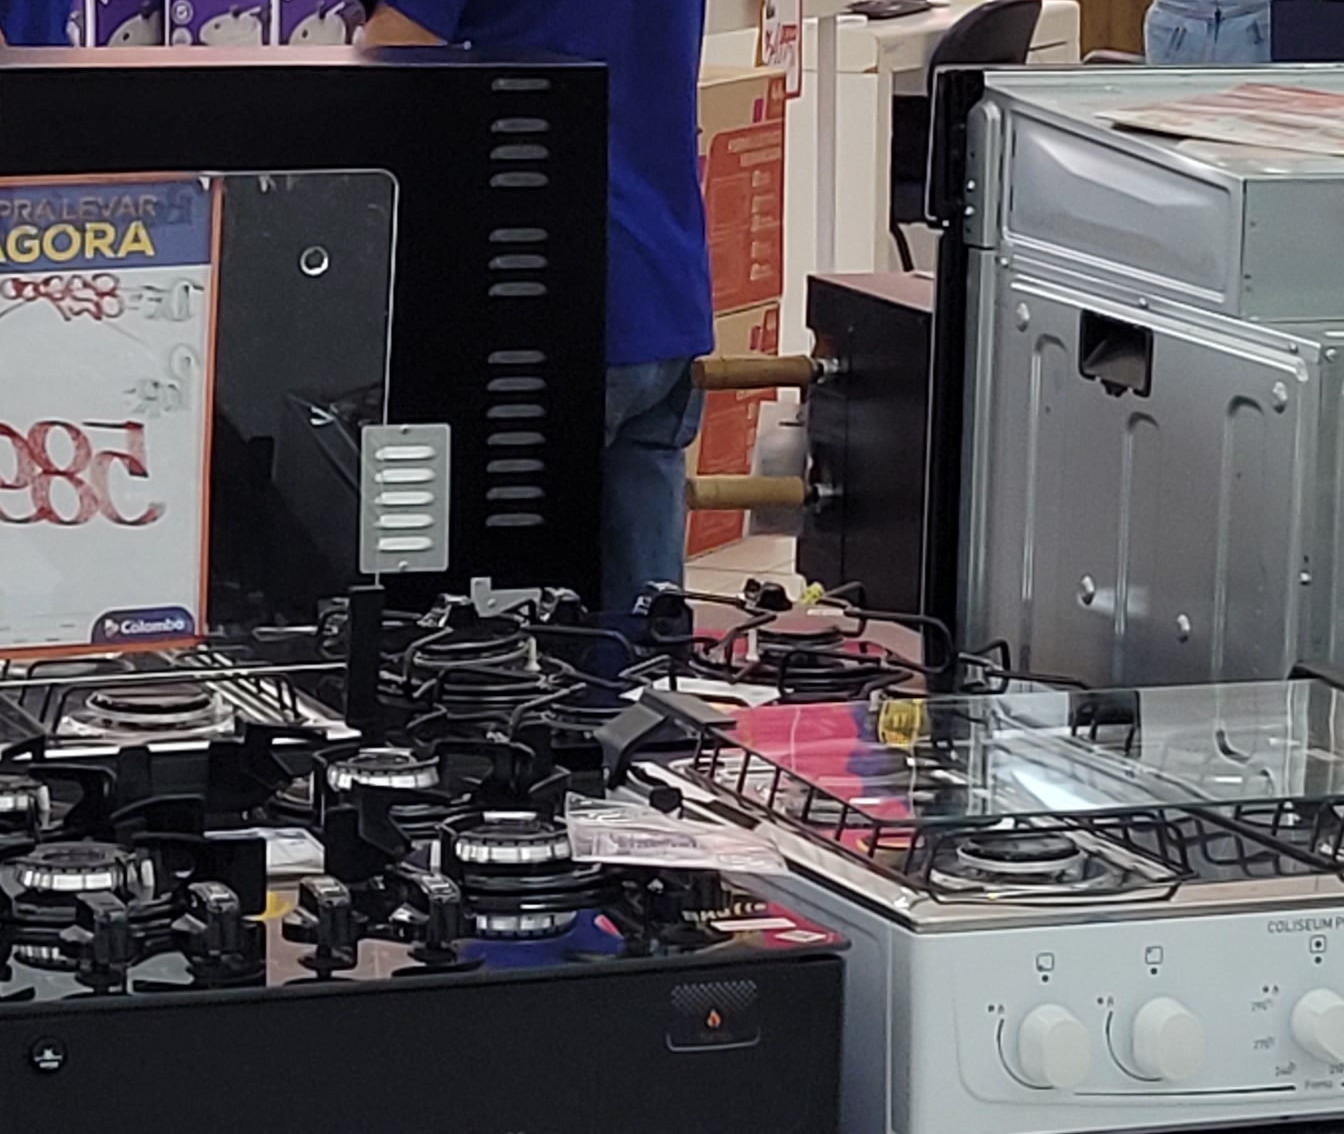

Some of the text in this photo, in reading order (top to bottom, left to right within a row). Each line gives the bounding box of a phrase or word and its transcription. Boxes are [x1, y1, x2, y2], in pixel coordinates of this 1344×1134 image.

[62, 195, 156, 220] LEVAR
[120, 617, 185, 635] Colombo
[1267, 917, 1333, 934] COLISEUM
